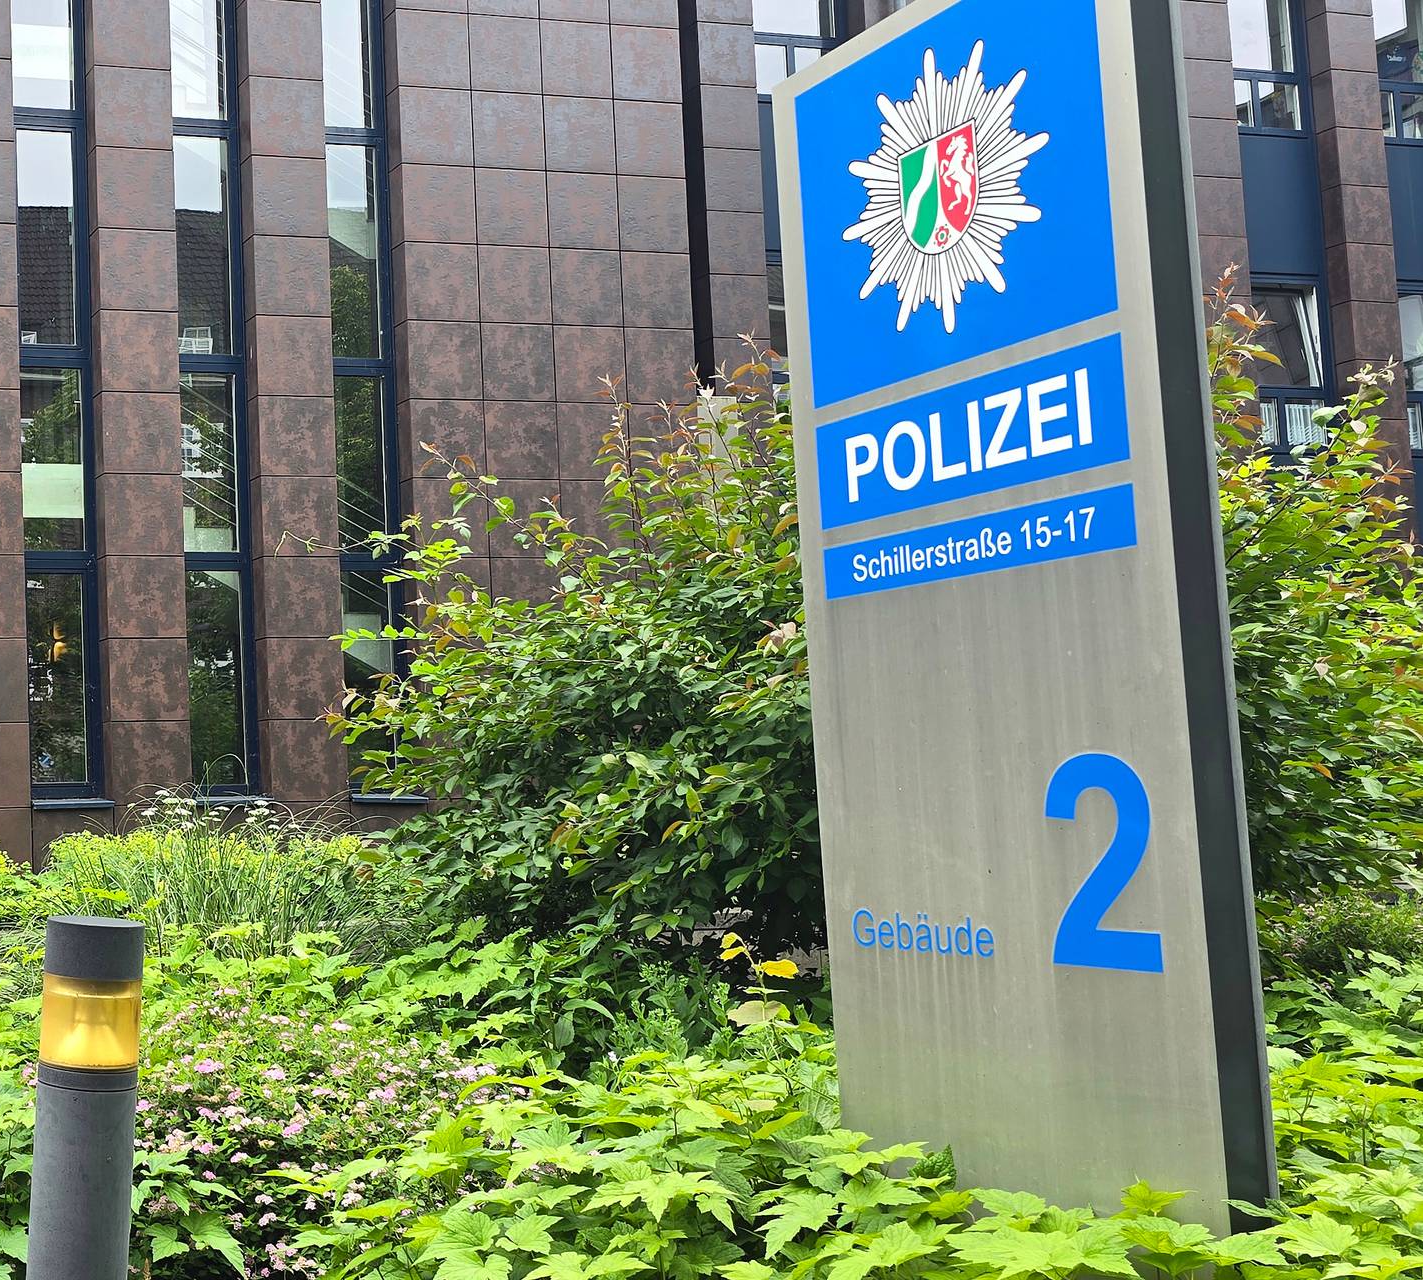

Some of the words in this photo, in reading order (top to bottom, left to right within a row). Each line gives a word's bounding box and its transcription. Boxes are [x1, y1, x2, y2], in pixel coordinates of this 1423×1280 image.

[845, 368, 1094, 503] POLIZEI
[851, 527, 1012, 582] Schillerstraße
[1020, 507, 1096, 550] 15-17
[1044, 752, 1165, 975] 2
[851, 907, 995, 959] Gebäude
